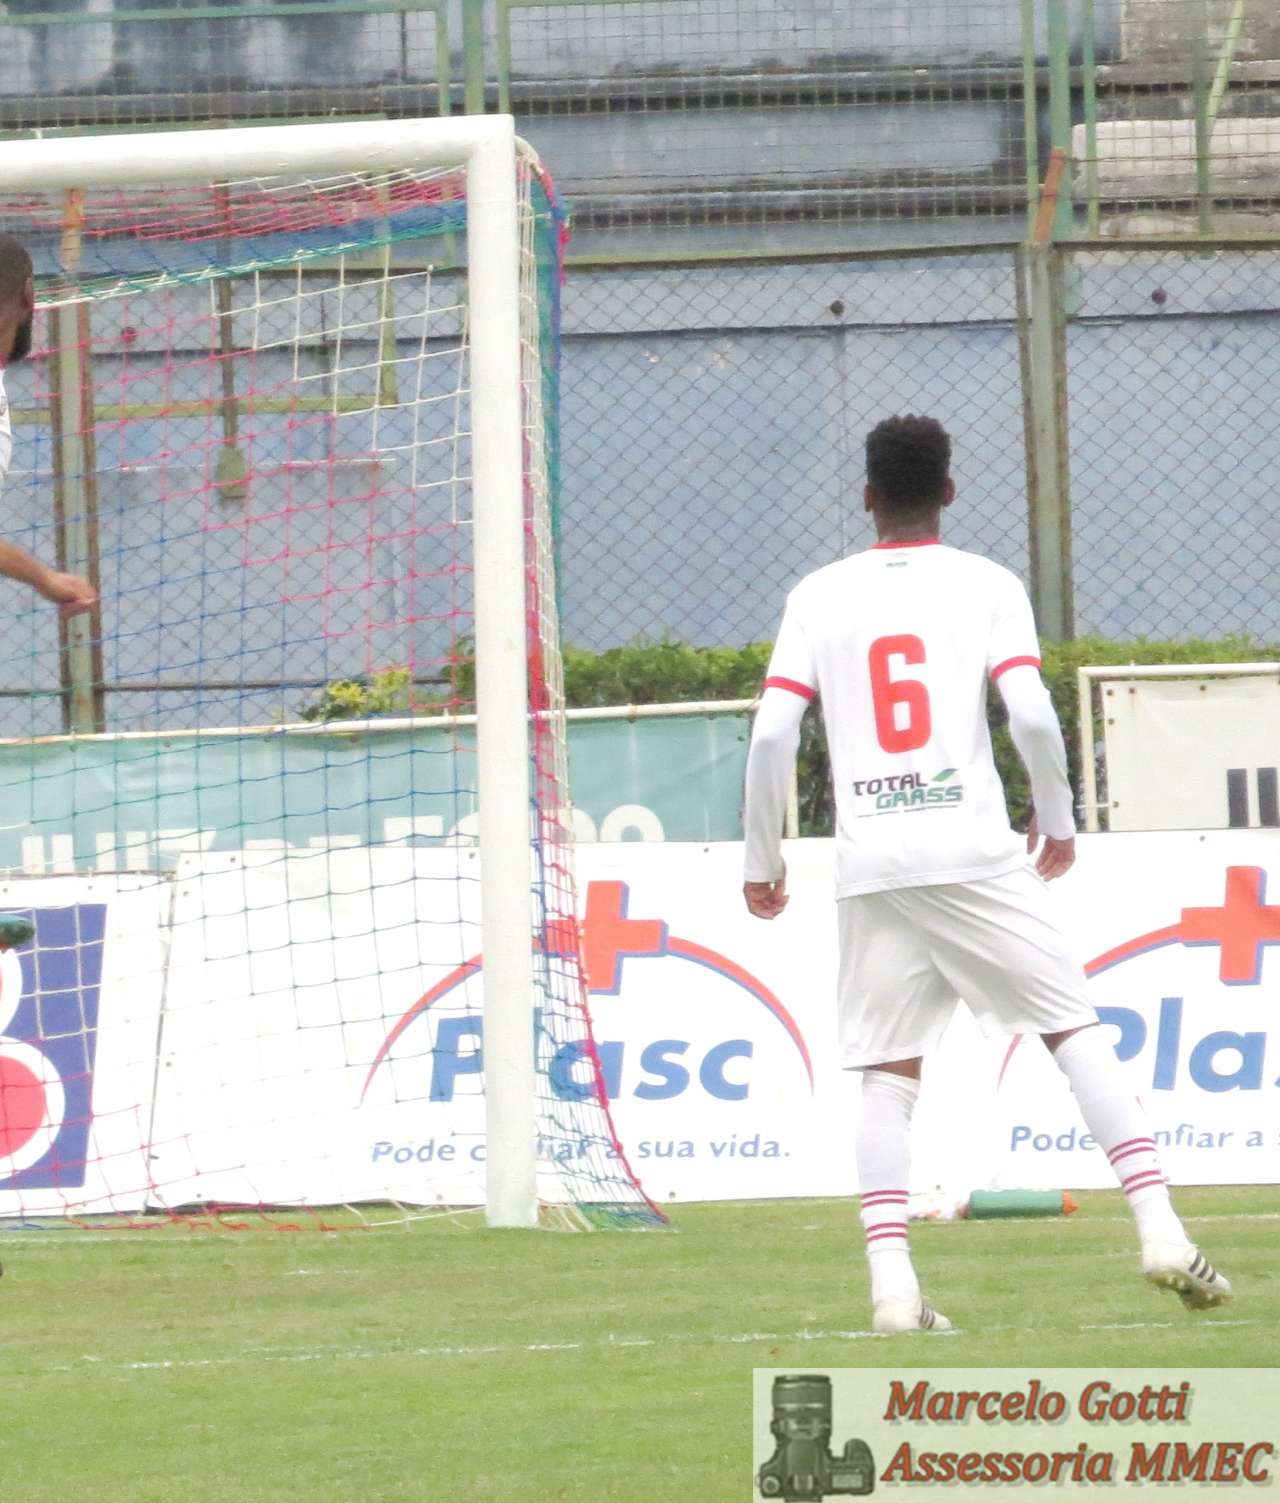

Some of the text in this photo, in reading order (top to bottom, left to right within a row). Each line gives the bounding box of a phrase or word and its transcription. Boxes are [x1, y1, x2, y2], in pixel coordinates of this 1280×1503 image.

[869, 634, 932, 754] 6
[853, 771, 928, 796] TOTAL
[372, 1140, 456, 1163] Pode
[638, 1141, 695, 1159] sua
[710, 1134, 791, 1160] vida.
[1010, 1125, 1098, 1152] Pode
[1246, 1130, 1264, 1147] a
